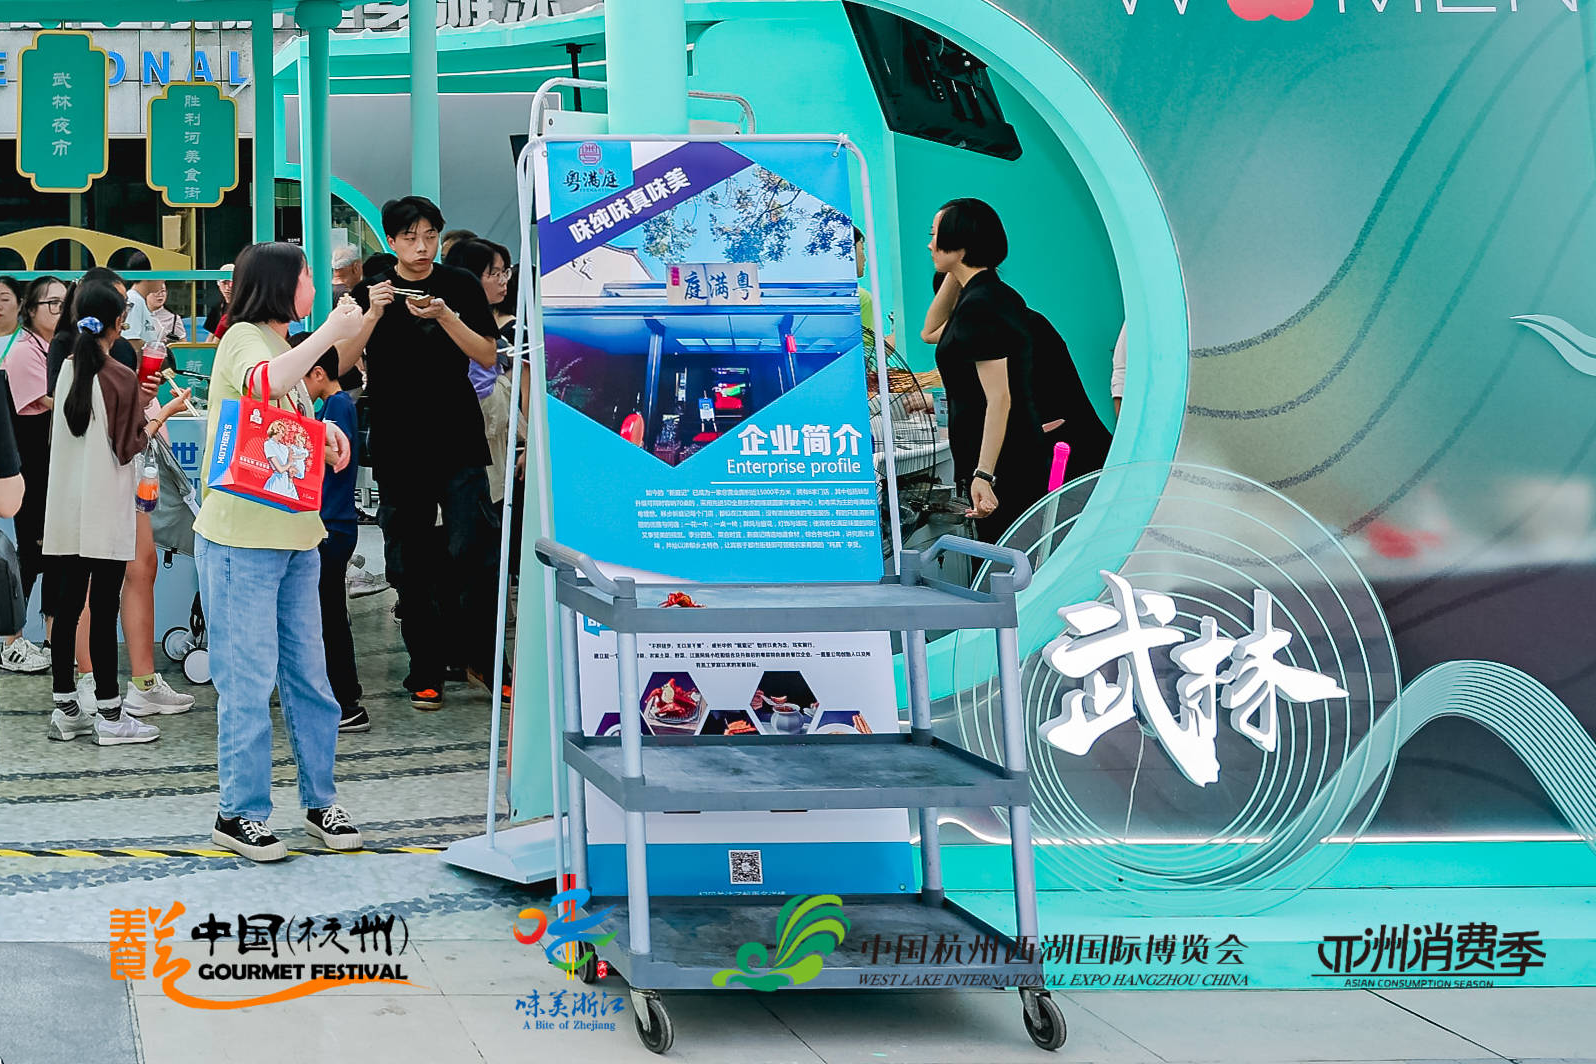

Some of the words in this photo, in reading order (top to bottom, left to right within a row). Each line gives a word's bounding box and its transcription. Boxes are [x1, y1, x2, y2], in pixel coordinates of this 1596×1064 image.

[50, 71, 73, 157] 武林夜市
[183, 94, 202, 201] 胜利河美食街
[567, 166, 692, 243] 味纯味真味美
[216, 423, 233, 464] MOTHER'S
[727, 458, 806, 478] Enterprise
[811, 458, 861, 478] profile
[737, 423, 863, 456] 企业简介
[1037, 569, 1350, 788] 武林
